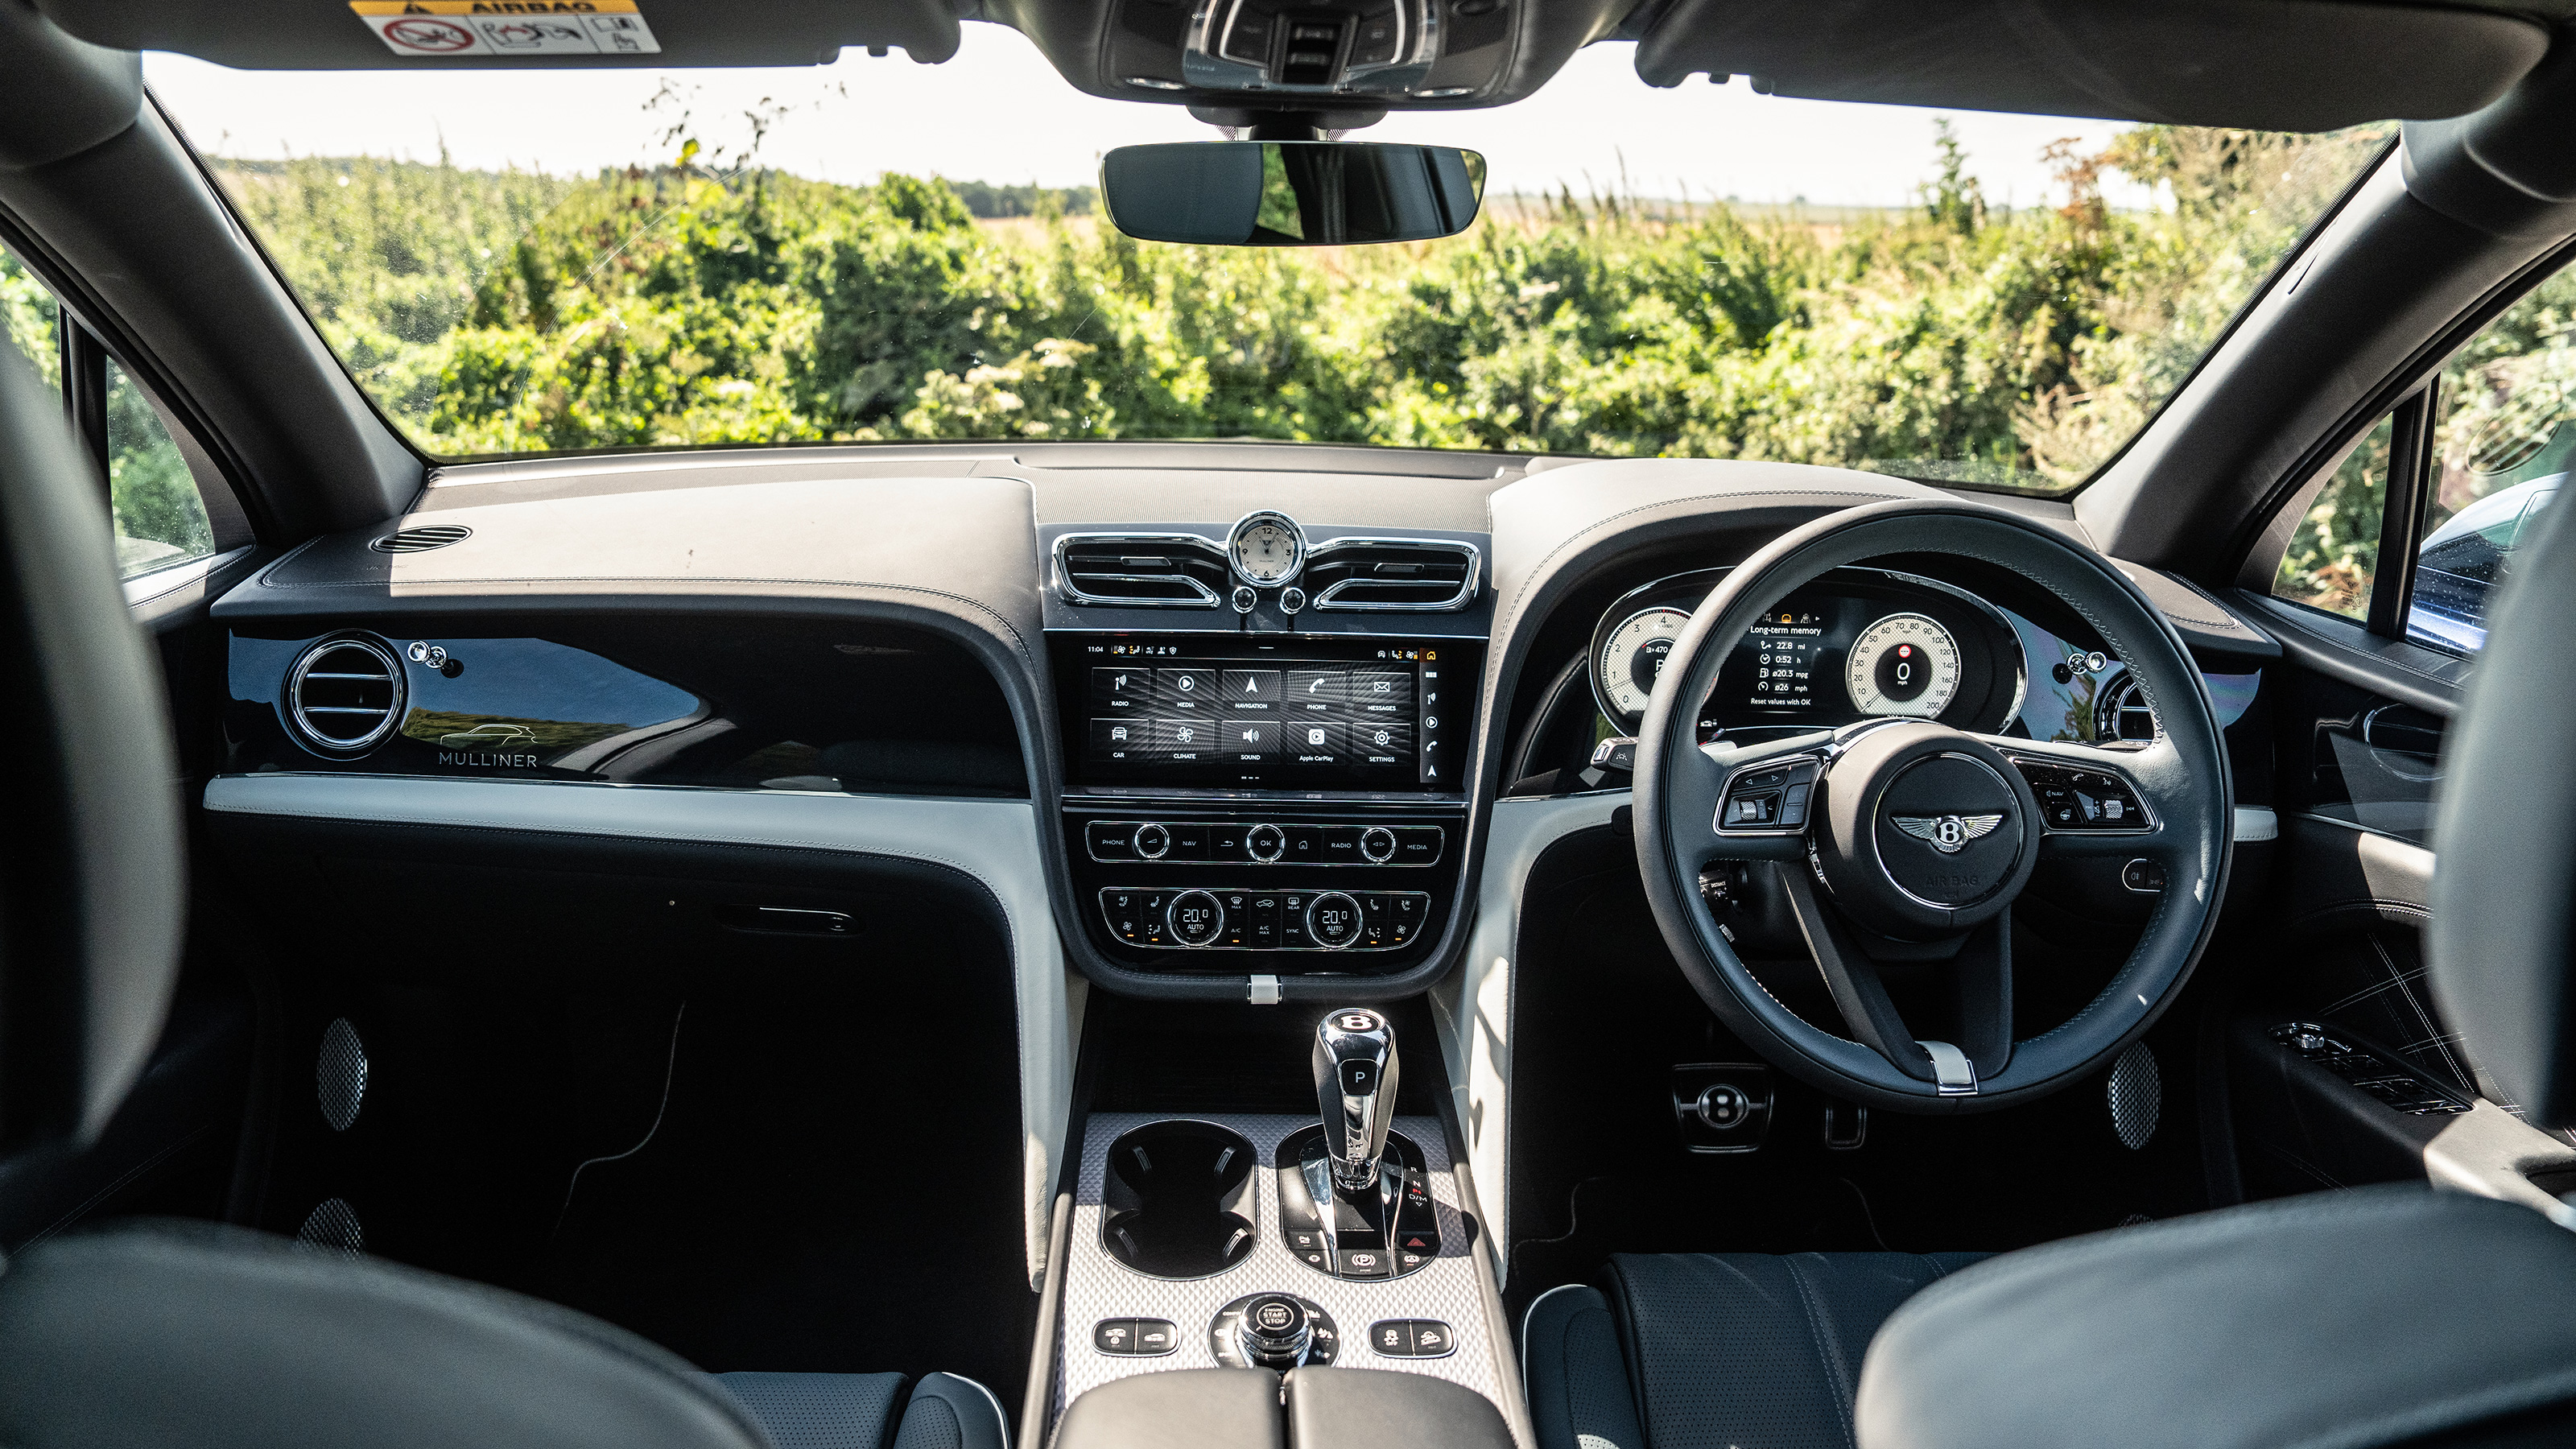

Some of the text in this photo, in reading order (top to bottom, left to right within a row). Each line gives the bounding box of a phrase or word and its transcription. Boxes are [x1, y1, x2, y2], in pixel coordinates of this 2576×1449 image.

[472, 2, 597, 14] AIRBAG
[1750, 625, 1822, 637] Long-term memory
[1616, 644, 1620, 652] 2
[1776, 642, 1793, 650] 22.8
[1775, 655, 1792, 663] 0:52
[1897, 663, 1910, 680] 0
[1623, 695, 1629, 704] 0
[439, 752, 538, 767] MULLINER
[1938, 821, 1960, 844] B
[1340, 1015, 1373, 1030] B
[1355, 1071, 1365, 1084] P
[1409, 1193, 1427, 1202] D/M
